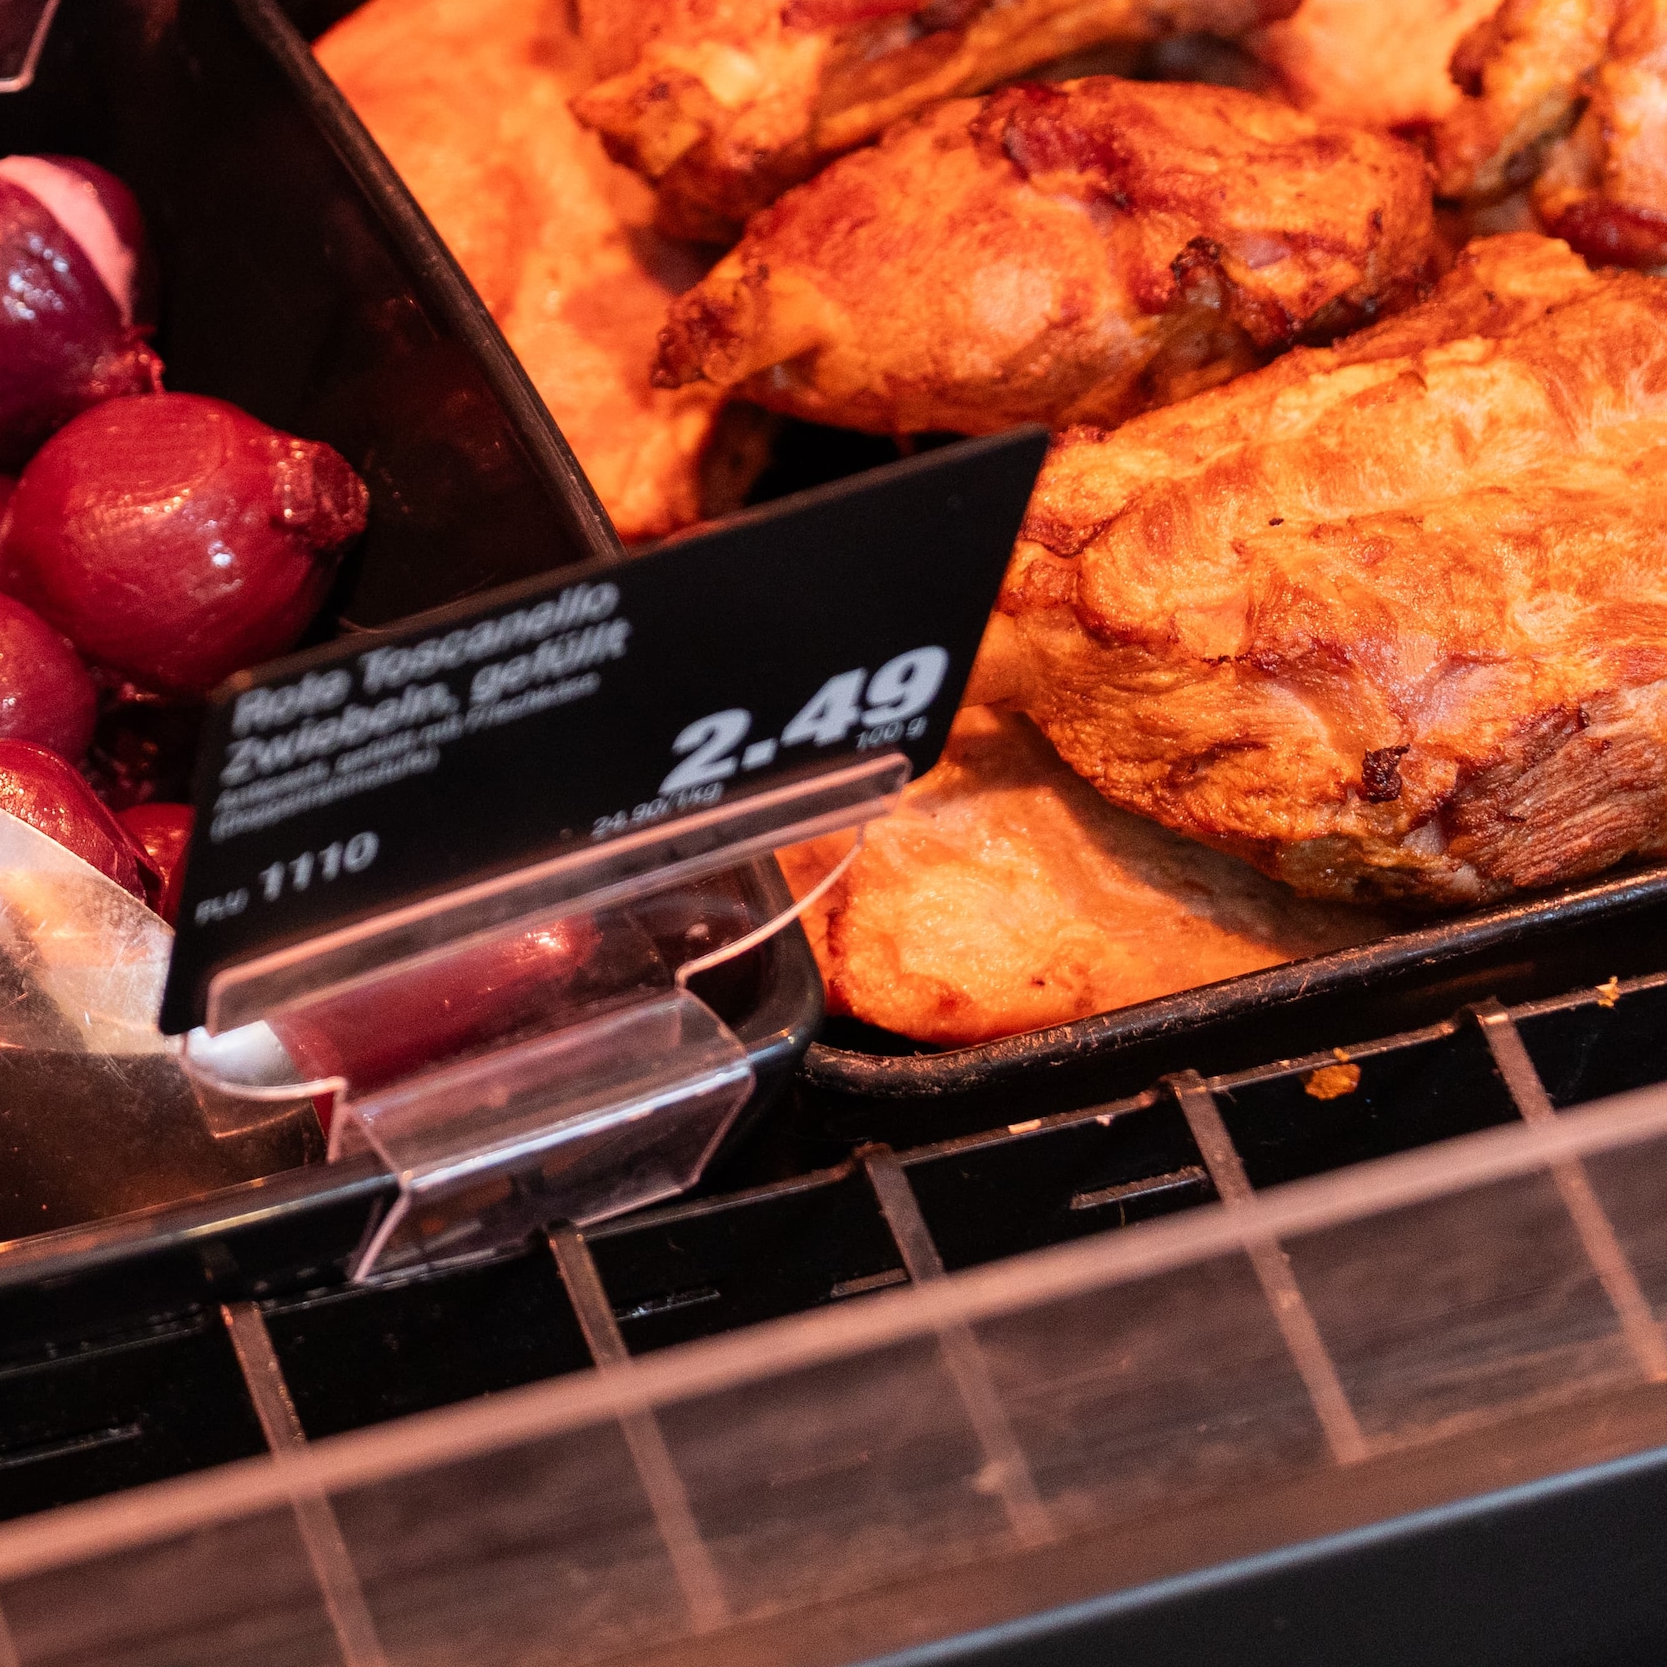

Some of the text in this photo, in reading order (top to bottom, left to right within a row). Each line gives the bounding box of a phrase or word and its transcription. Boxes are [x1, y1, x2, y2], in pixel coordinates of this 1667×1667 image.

[232, 582, 621, 733] Rote Toscanello
[469, 617, 632, 704] gefüllt
[658, 645, 949, 796] 2.49
[857, 720, 904, 751] 100
[194, 831, 379, 926] PLU 1110
